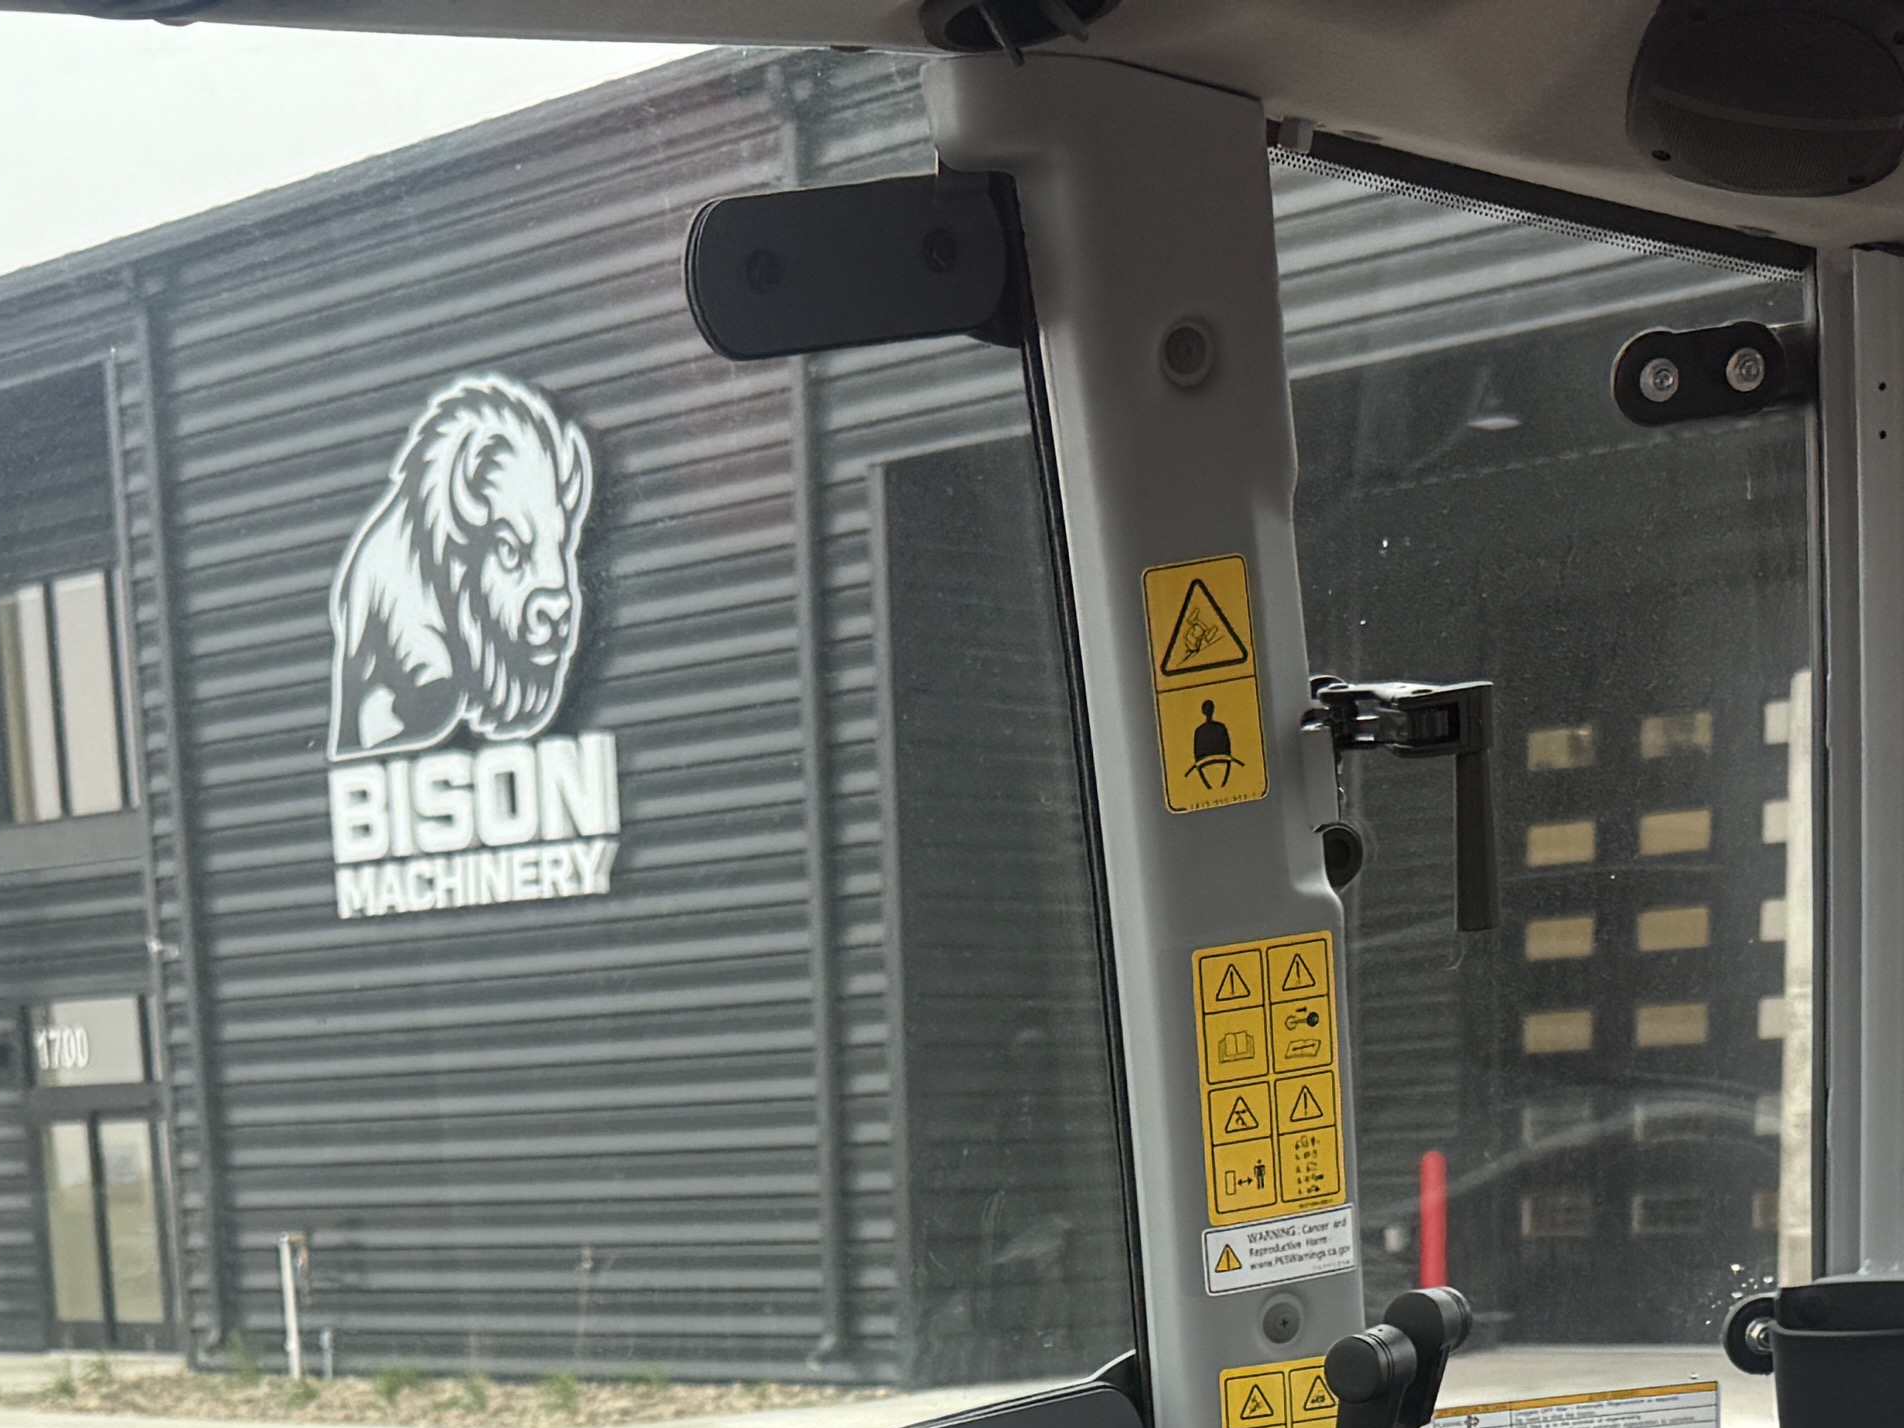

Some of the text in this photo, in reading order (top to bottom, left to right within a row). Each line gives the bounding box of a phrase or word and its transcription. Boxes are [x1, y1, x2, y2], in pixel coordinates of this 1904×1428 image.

[329, 729, 621, 865] BISON
[336, 838, 619, 919] MACHINERY
[34, 1025, 89, 1070] 1700
